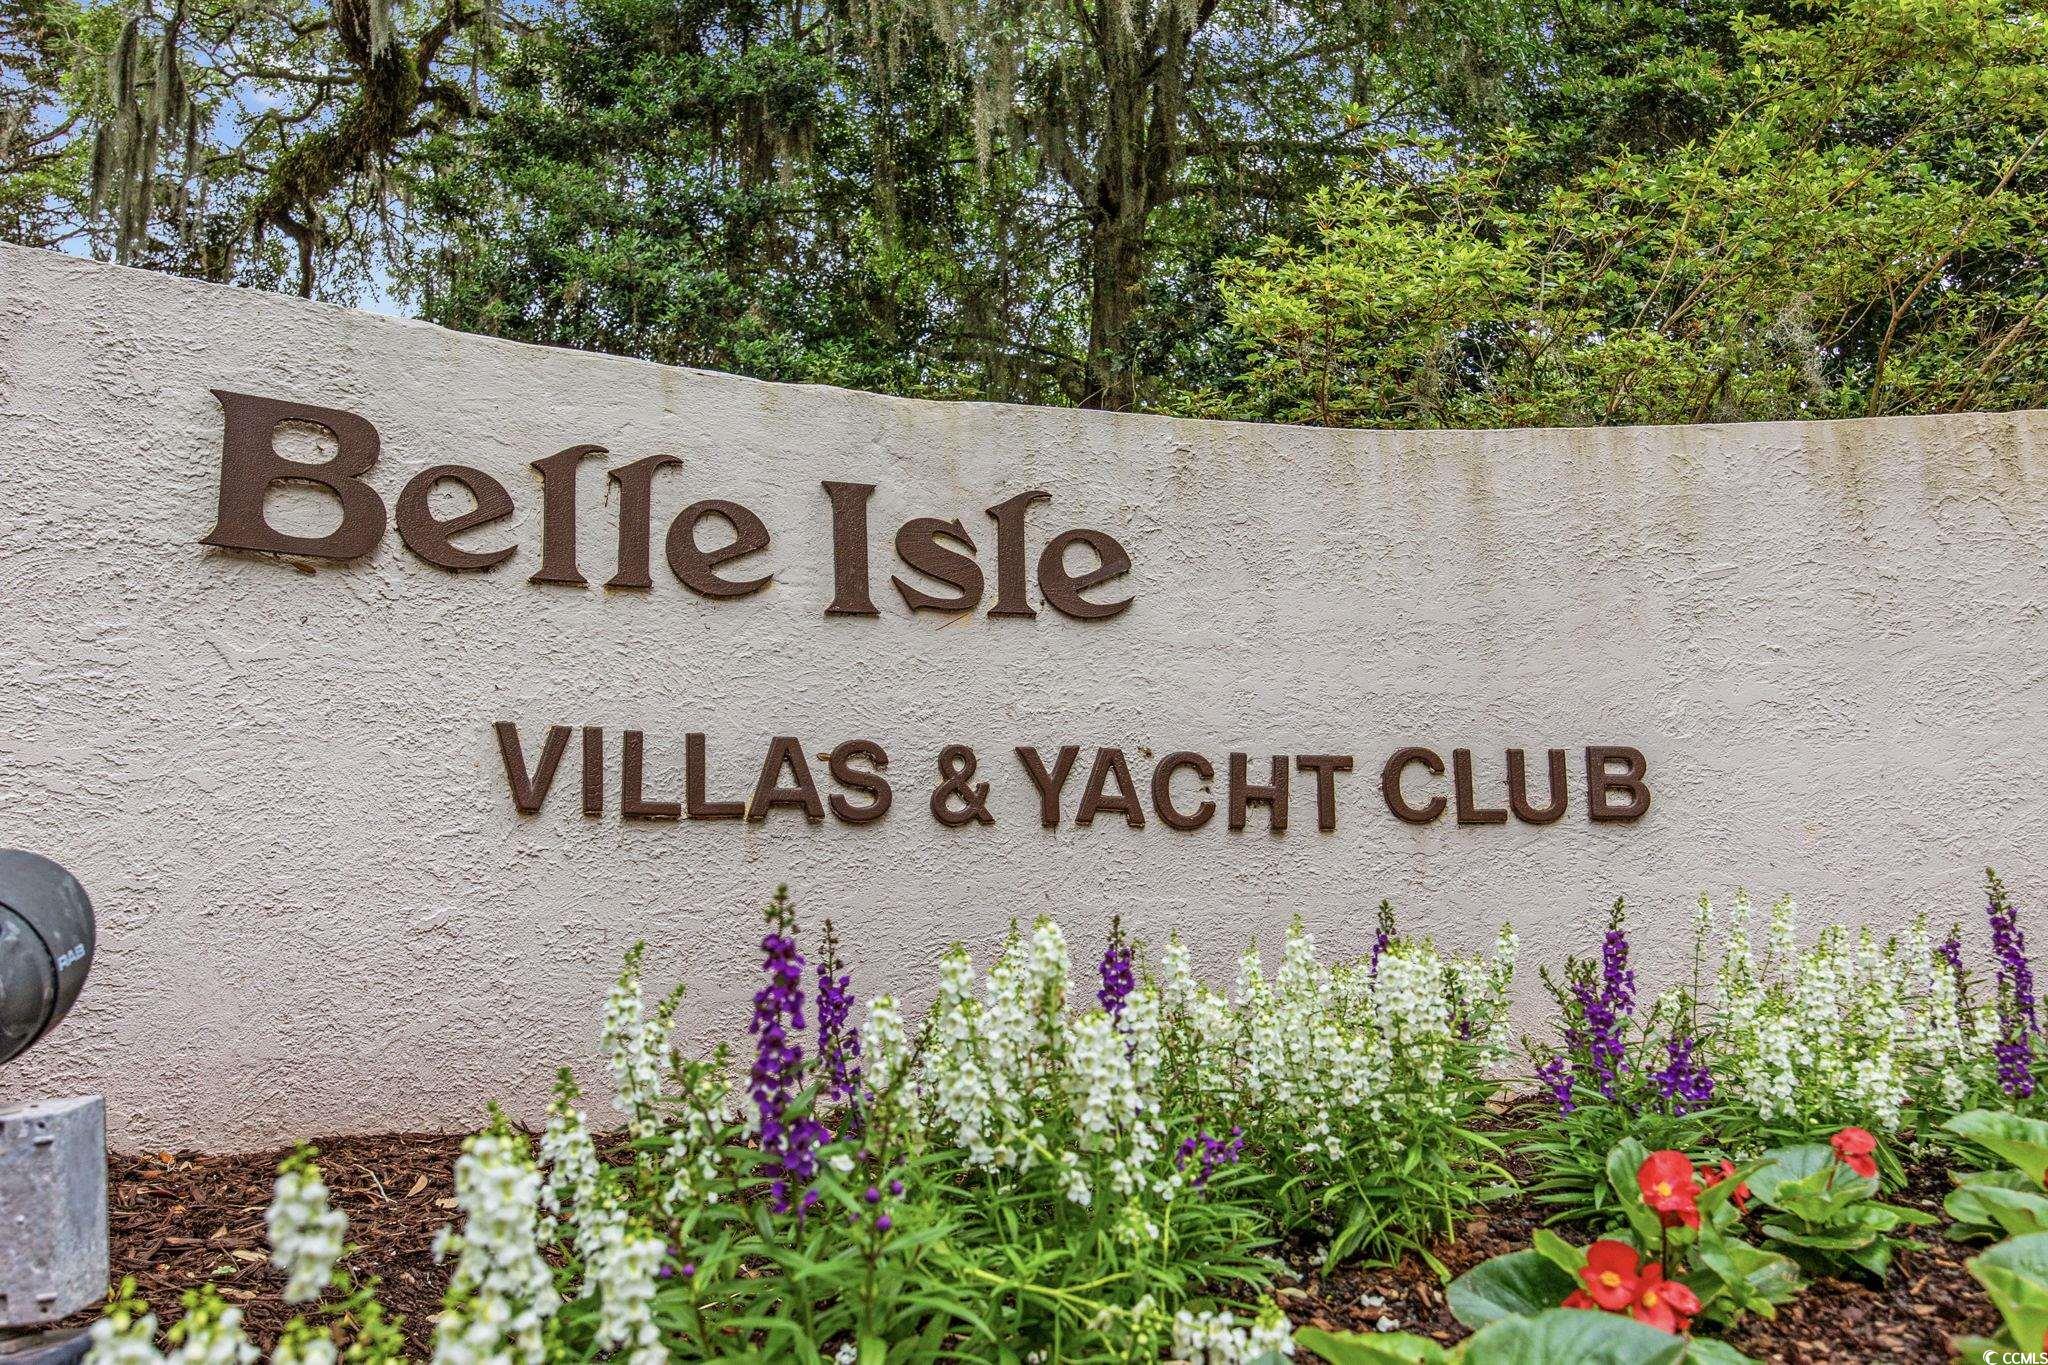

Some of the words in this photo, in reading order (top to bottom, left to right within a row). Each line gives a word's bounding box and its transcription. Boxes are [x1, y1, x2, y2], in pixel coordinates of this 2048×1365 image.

[199, 388, 774, 597] Belle
[821, 480, 1135, 618] Isle
[495, 721, 893, 824] VILLAS
[930, 744, 996, 827] &
[1014, 745, 1353, 831] YACHT
[1381, 746, 1652, 825] CLUB
